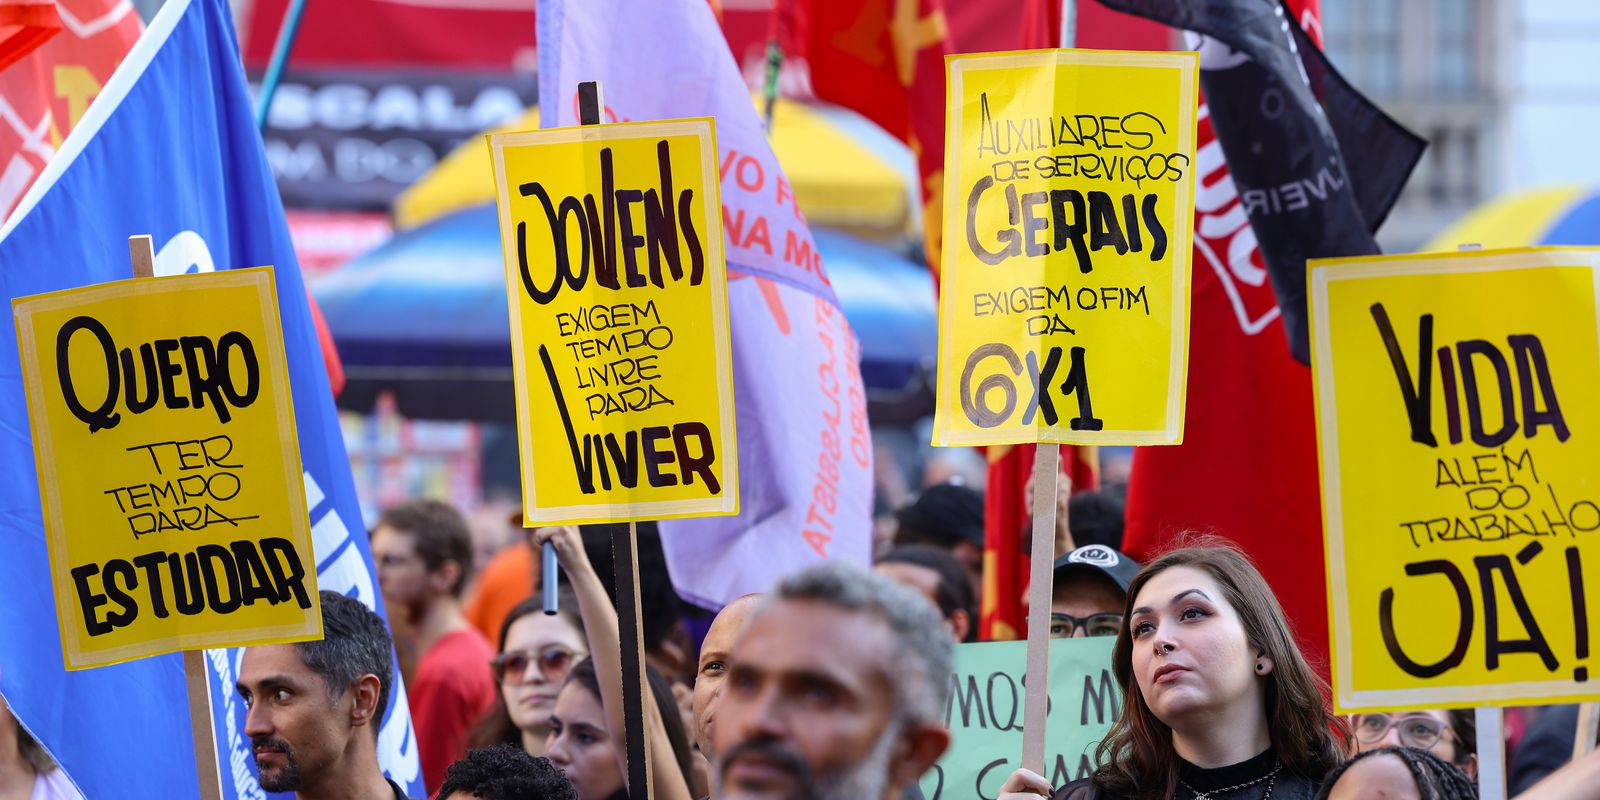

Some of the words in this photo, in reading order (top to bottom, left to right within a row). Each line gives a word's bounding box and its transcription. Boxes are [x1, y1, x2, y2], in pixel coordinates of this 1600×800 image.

[979, 92, 1167, 159] AUXILIARES
[992, 158, 1031, 183] DE
[1034, 152, 1190, 189] SERVIÇOS
[517, 140, 704, 305] JOVENS
[966, 175, 1168, 274] GERAIS
[556, 300, 661, 337] EXIGEM
[975, 286, 1071, 317] EXIGEM
[1076, 287, 1098, 311] O
[1101, 285, 1150, 316] FIM
[566, 326, 673, 361] TEMPO
[1027, 313, 1076, 337] DA
[56, 316, 260, 434] QUERO
[574, 355, 662, 389] LIVRE
[960, 342, 1104, 431] 6X1
[1370, 301, 1571, 449] VIDA
[538, 344, 721, 495] VIVER
[586, 385, 675, 421] PARA
[126, 435, 243, 475] TER
[104, 472, 241, 514] TEMPO
[1466, 485, 1530, 511] DO
[128, 505, 260, 540] PARA
[1400, 484, 1600, 547] TRABALHO
[70, 536, 312, 637] ESTUDAR
[1379, 540, 1589, 683] JÁ!
